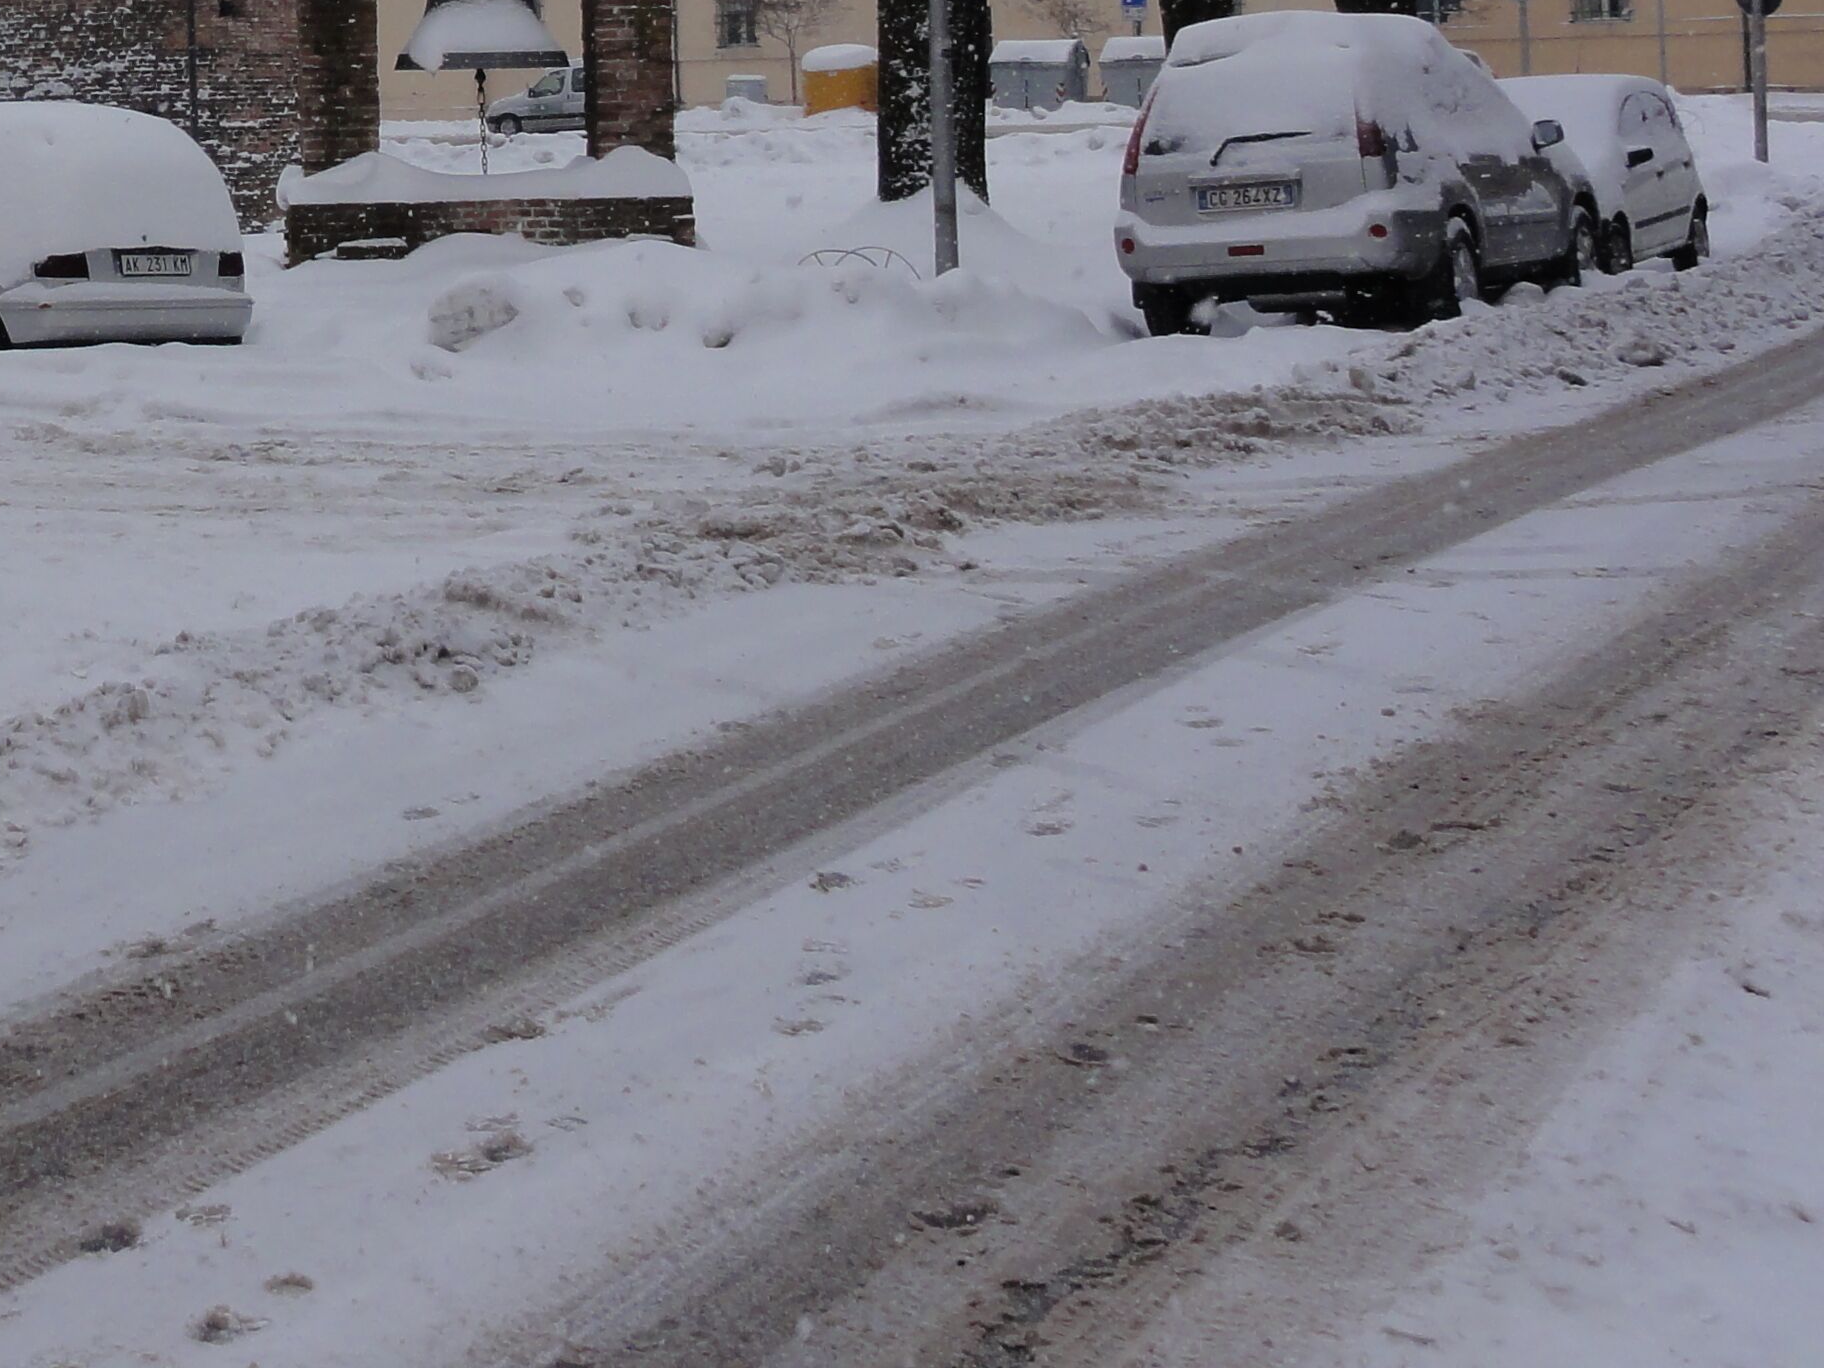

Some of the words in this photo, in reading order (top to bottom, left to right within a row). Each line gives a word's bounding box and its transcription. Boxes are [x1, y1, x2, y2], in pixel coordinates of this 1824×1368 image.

[125, 257, 140, 273] AK
[146, 256, 168, 273] 231
[173, 256, 189, 273] KM
